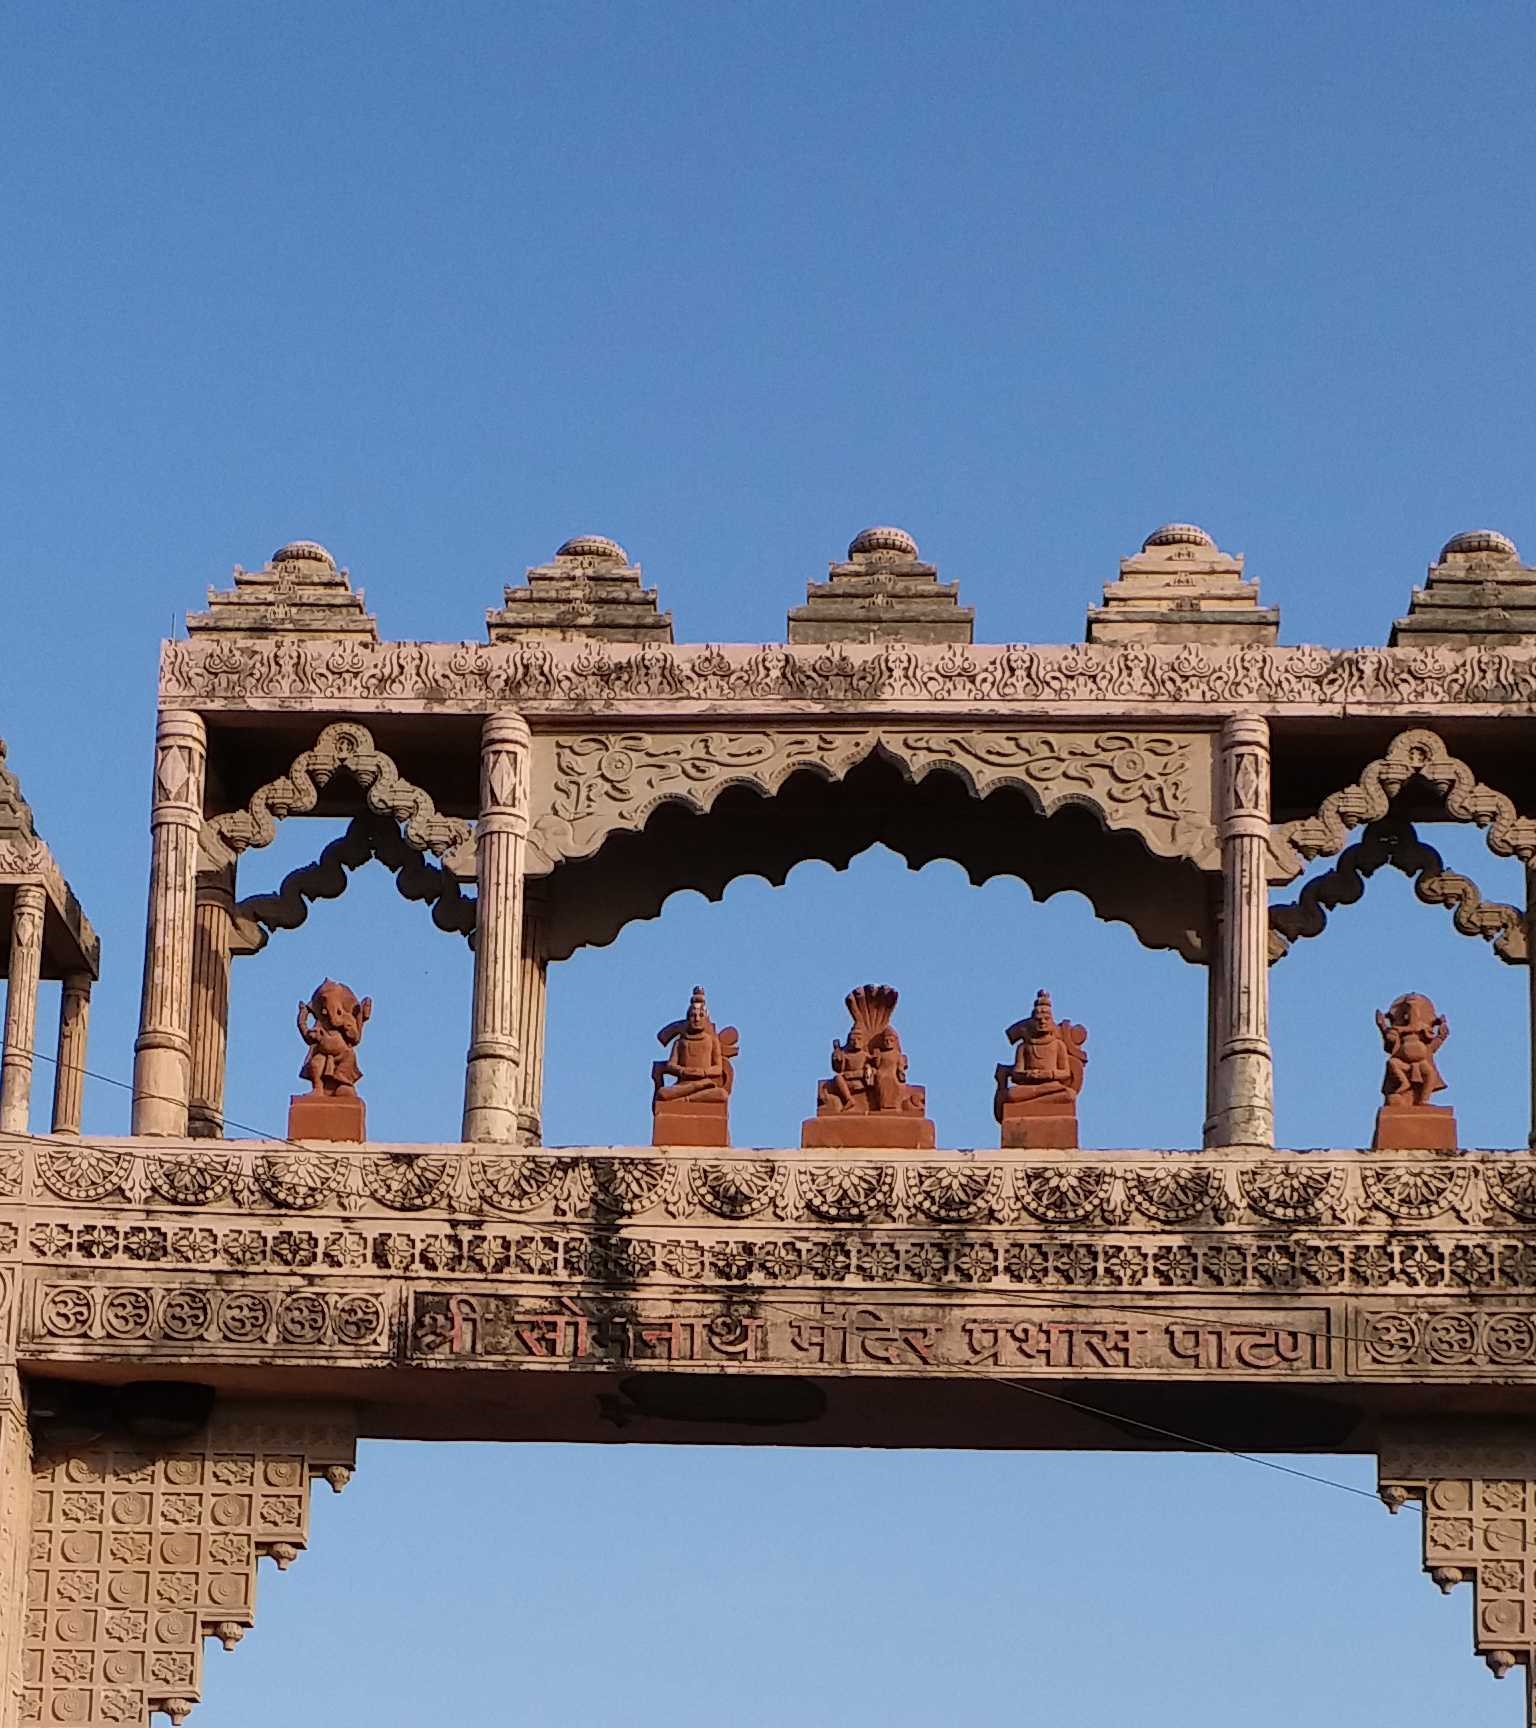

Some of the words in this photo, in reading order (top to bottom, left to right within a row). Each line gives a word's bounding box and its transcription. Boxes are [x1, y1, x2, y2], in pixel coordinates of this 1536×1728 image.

[414, 1295, 494, 1355] श्री
[513, 1296, 764, 1361] सोमनाथ
[790, 1300, 943, 1366] मंदिर
[964, 1320, 1146, 1368] प्रभास
[1167, 1322, 1330, 1370] पाटण
